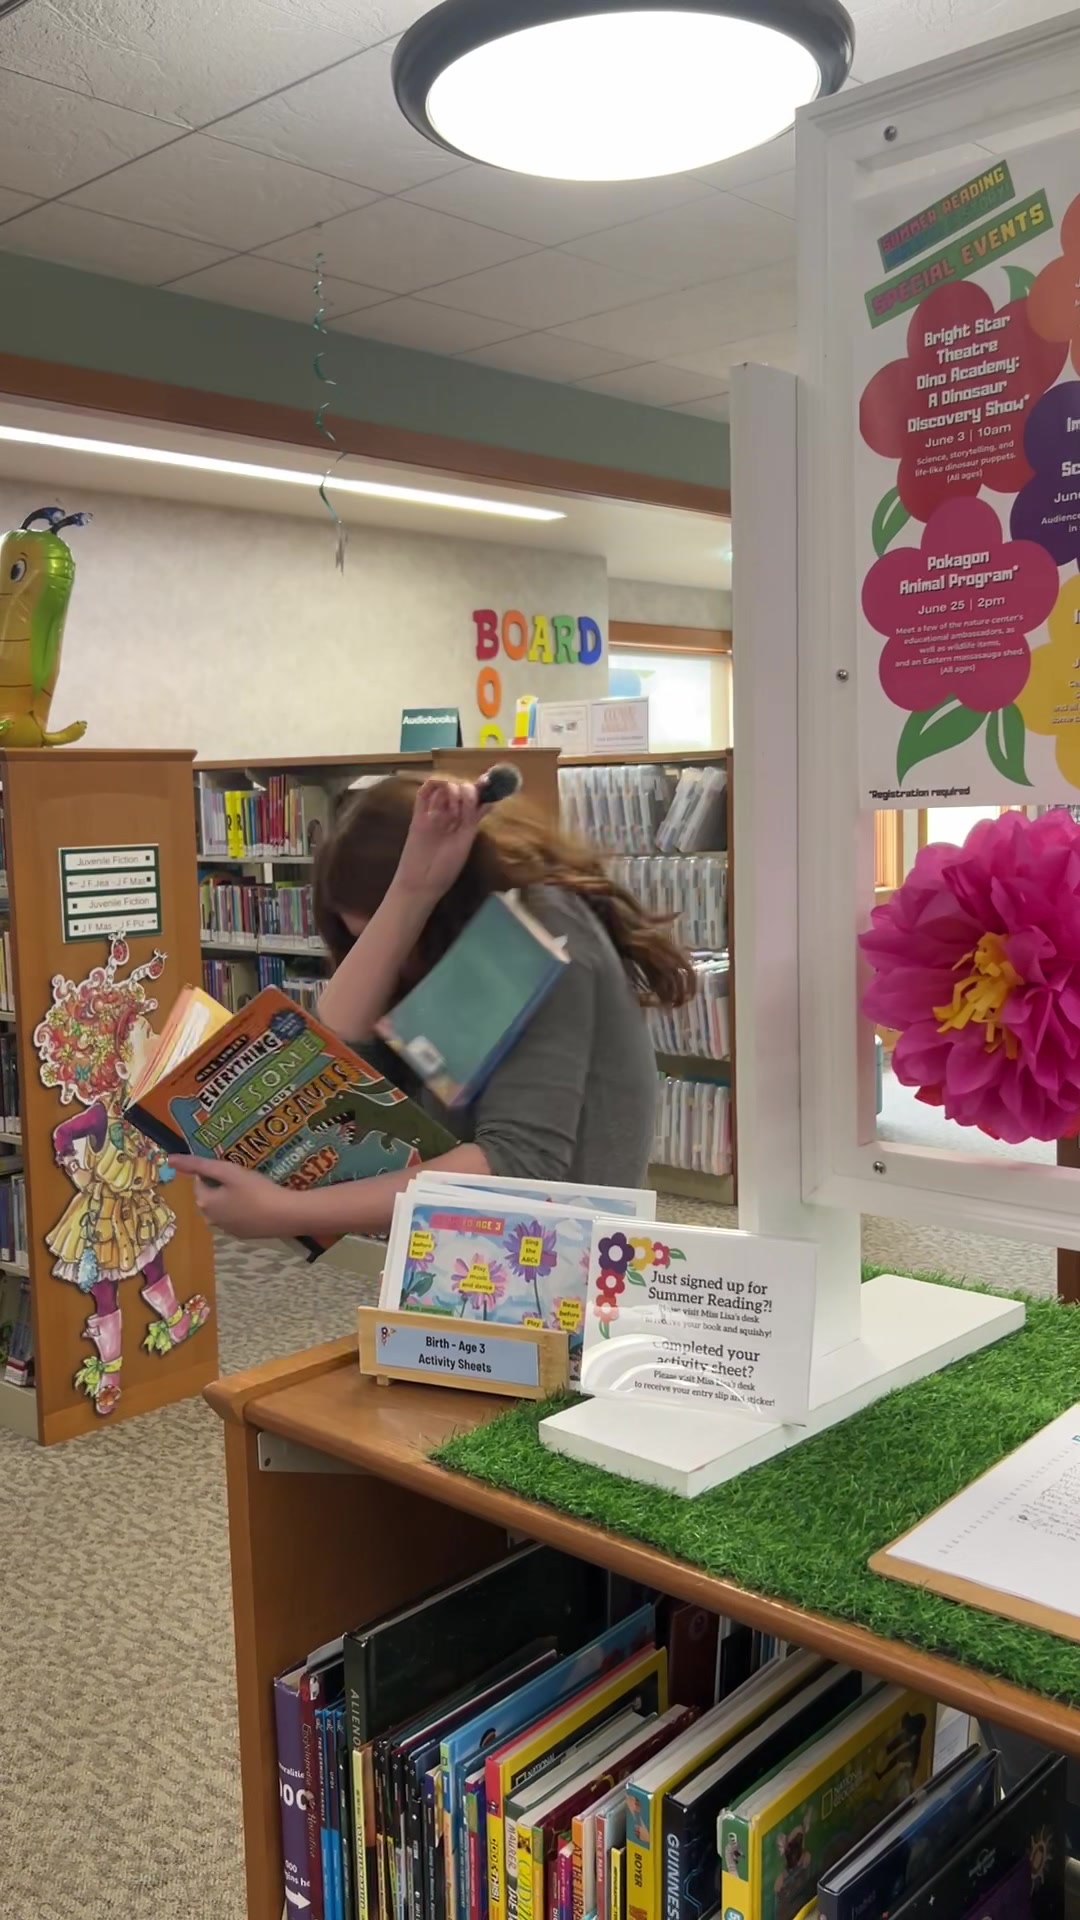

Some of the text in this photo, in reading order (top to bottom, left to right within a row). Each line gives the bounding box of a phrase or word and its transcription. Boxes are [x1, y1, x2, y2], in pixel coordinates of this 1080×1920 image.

[882, 211, 938, 252] SUMMER
[943, 167, 1005, 214] READING
[872, 259, 956, 317] SPECIAL
[962, 202, 1045, 265] EVENTS
[924, 316, 1010, 347] Bright Star
[937, 340, 998, 364] Theatre
[917, 356, 1020, 390] Dino Academy:
[929, 381, 1007, 408] A Dinosaur
[908, 407, 981, 432] Discovery
[925, 424, 1012, 448] June 3 10am
[917, 440, 1014, 465] Science, storytelling, and
[915, 452, 1016, 477] life-like dinosaur puppets.
[947, 469, 983, 484] (All ages)
[1054, 490, 1080, 503] Jun
[927, 551, 989, 571] Pokagon
[900, 575, 945, 594] Animal
[918, 596, 1005, 615] June 25 2pm
[895, 627, 916, 635] Meet
[923, 624, 939, 632] few
[939, 622, 947, 630] of
[949, 621, 962, 629] the
[963, 618, 990, 627] nature
[991, 614, 1024, 624] center's
[473, 609, 602, 666] BOARD
[904, 635, 950, 645] educational
[919, 645, 935, 654] well
[947, 641, 976, 651] wildlife
[895, 648, 1024, 667] and an Eastern massasauga shed.
[940, 664, 976, 675] (All ages)
[402, 715, 458, 725] Audiobooks
[931, 786, 970, 798] required
[77, 855, 139, 866] Juvenile Fiction
[89, 897, 150, 909] Juvenile Fiction
[199, 1033, 279, 1109] EVERYTHING
[200, 1035, 318, 1146] AWESOME
[224, 1062, 349, 1169] DINOSAURS
[286, 1146, 339, 1190] ASTS!
[475, 1220, 502, 1231] AGE 3
[525, 1238, 539, 1247] Sing
[521, 1256, 539, 1264] ABCs
[475, 1283, 493, 1291] dance
[651, 1270, 768, 1295] Just signed up for
[562, 1301, 579, 1309] Read
[648, 1287, 772, 1314] Summer Reading?!
[526, 1320, 541, 1328] Play
[559, 1310, 580, 1319] before
[562, 1319, 575, 1327] bed
[683, 1307, 760, 1323] visit Miss Lisa's desk
[683, 1320, 773, 1338] your book and squishy!
[426, 1336, 450, 1349] Birth
[458, 1340, 477, 1354] Age
[479, 1343, 486, 1354] 3
[727, 1348, 761, 1362] your
[418, 1353, 492, 1373] Activity Sheets
[711, 1361, 754, 1378] sheet?
[634, 1380, 642, 1388] to
[643, 1382, 671, 1392] receive
[672, 1385, 690, 1395] your
[692, 1387, 713, 1399] entry
[715, 1390, 729, 1401] slip
[653, 1370, 677, 1380] Please
[697, 1376, 714, 1386] Miss
[737, 1380, 756, 1391] desk
[303, 1723, 313, 1787] Encyclopedia
[506, 1823, 517, 1871] MAURER
[572, 1842, 582, 1861] AT
[572, 1862, 583, 1886] THE
[634, 1852, 643, 1888] BOYER
[508, 1885, 518, 1910] THE
